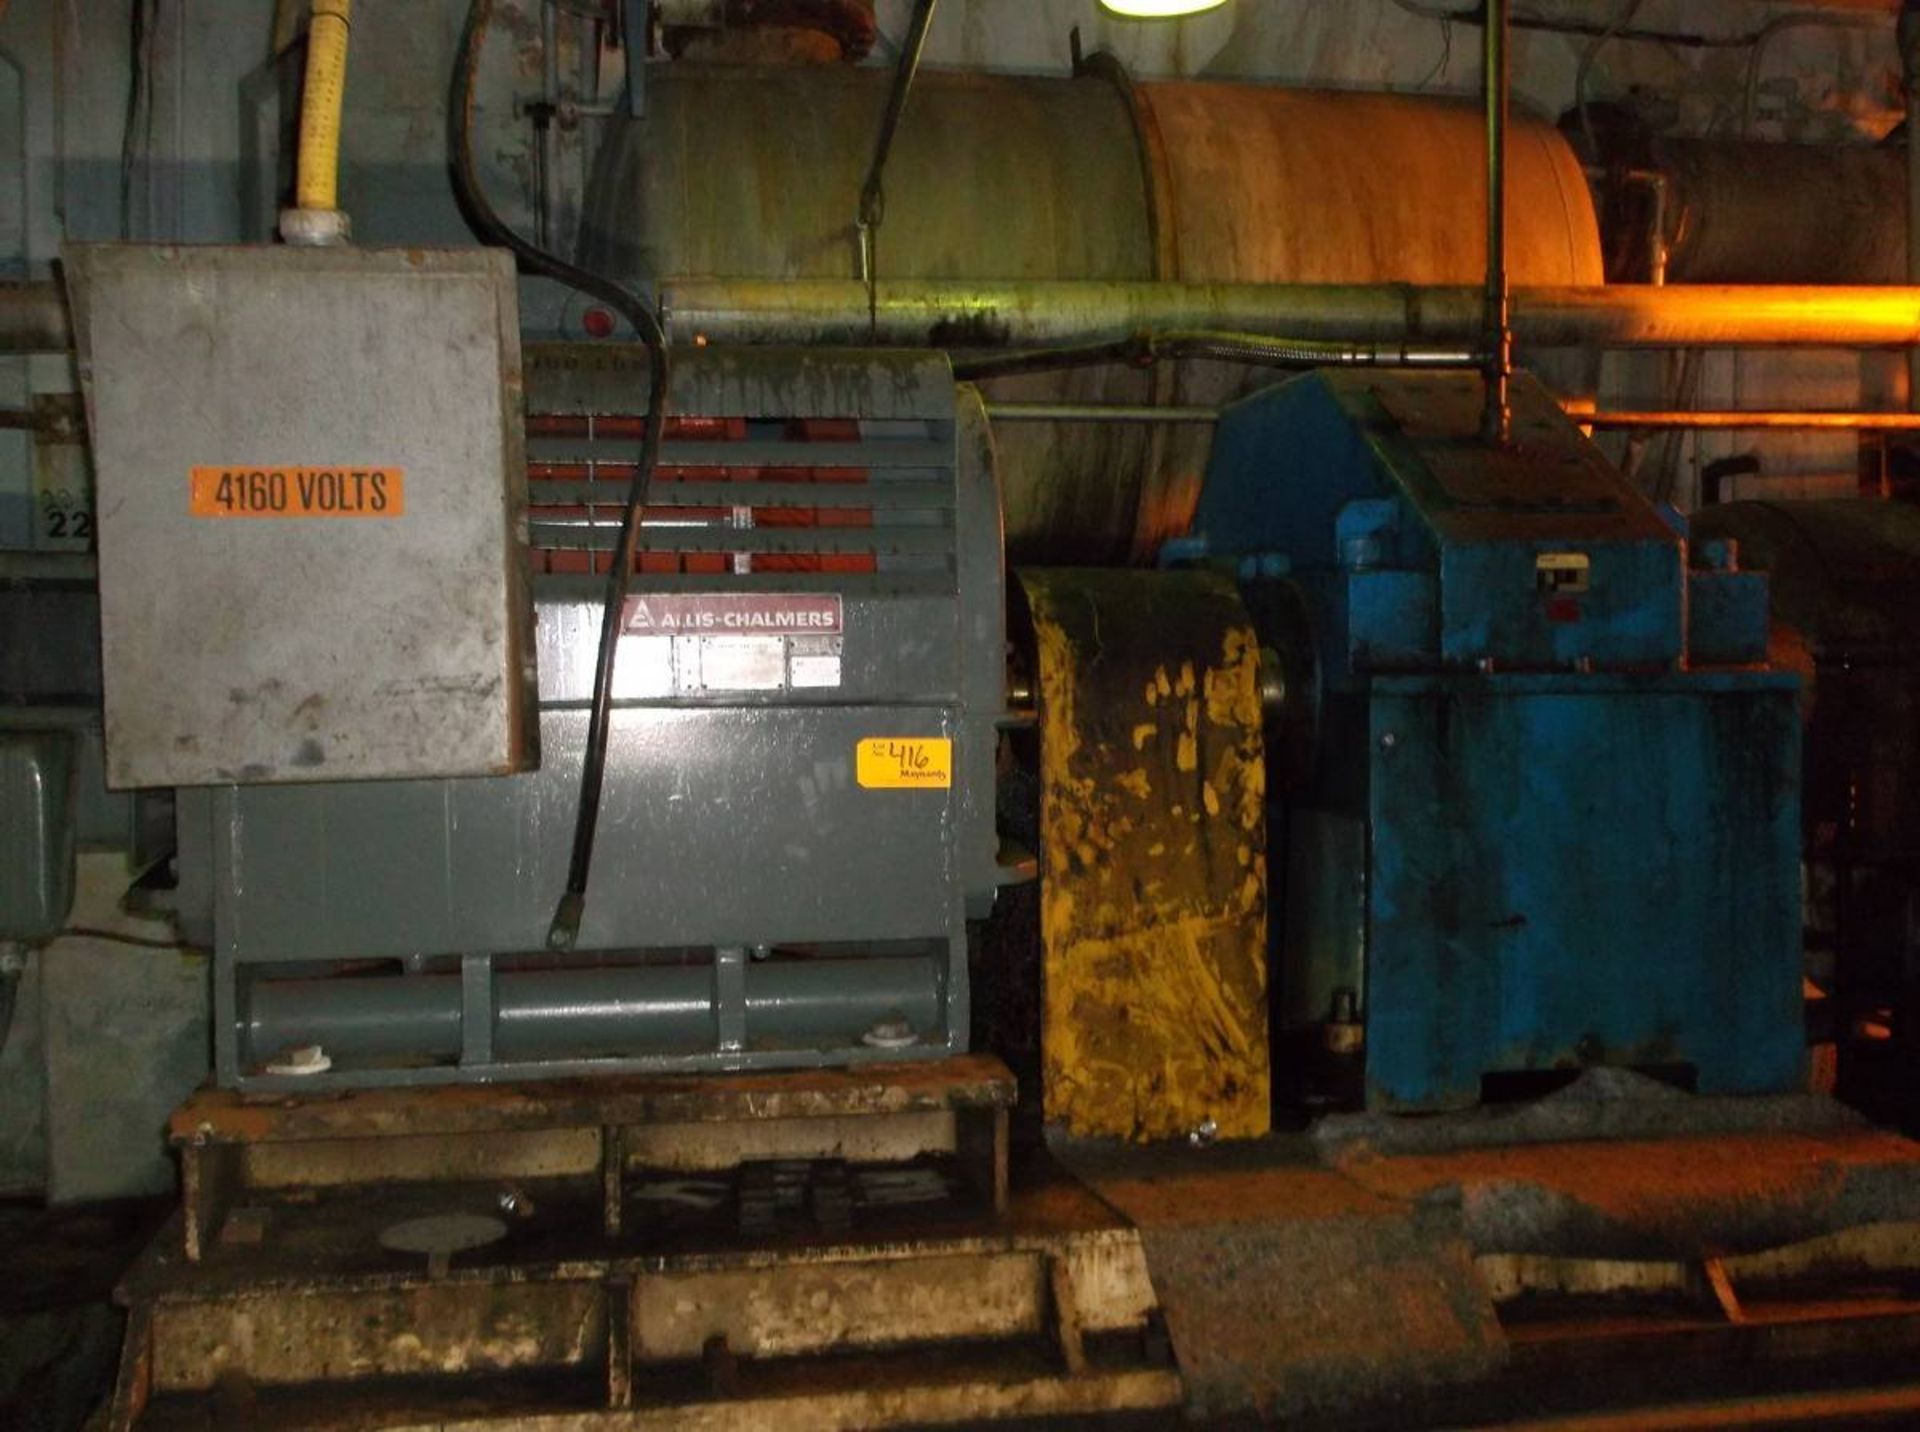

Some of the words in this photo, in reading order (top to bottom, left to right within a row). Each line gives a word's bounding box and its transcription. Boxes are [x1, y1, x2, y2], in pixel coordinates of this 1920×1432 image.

[215, 472, 287, 511] 4160
[297, 472, 387, 511] VOLTS
[48, 510, 89, 538] 22
[660, 611, 834, 628] ALLIS-CHALMERS
[889, 742, 928, 769] 416
